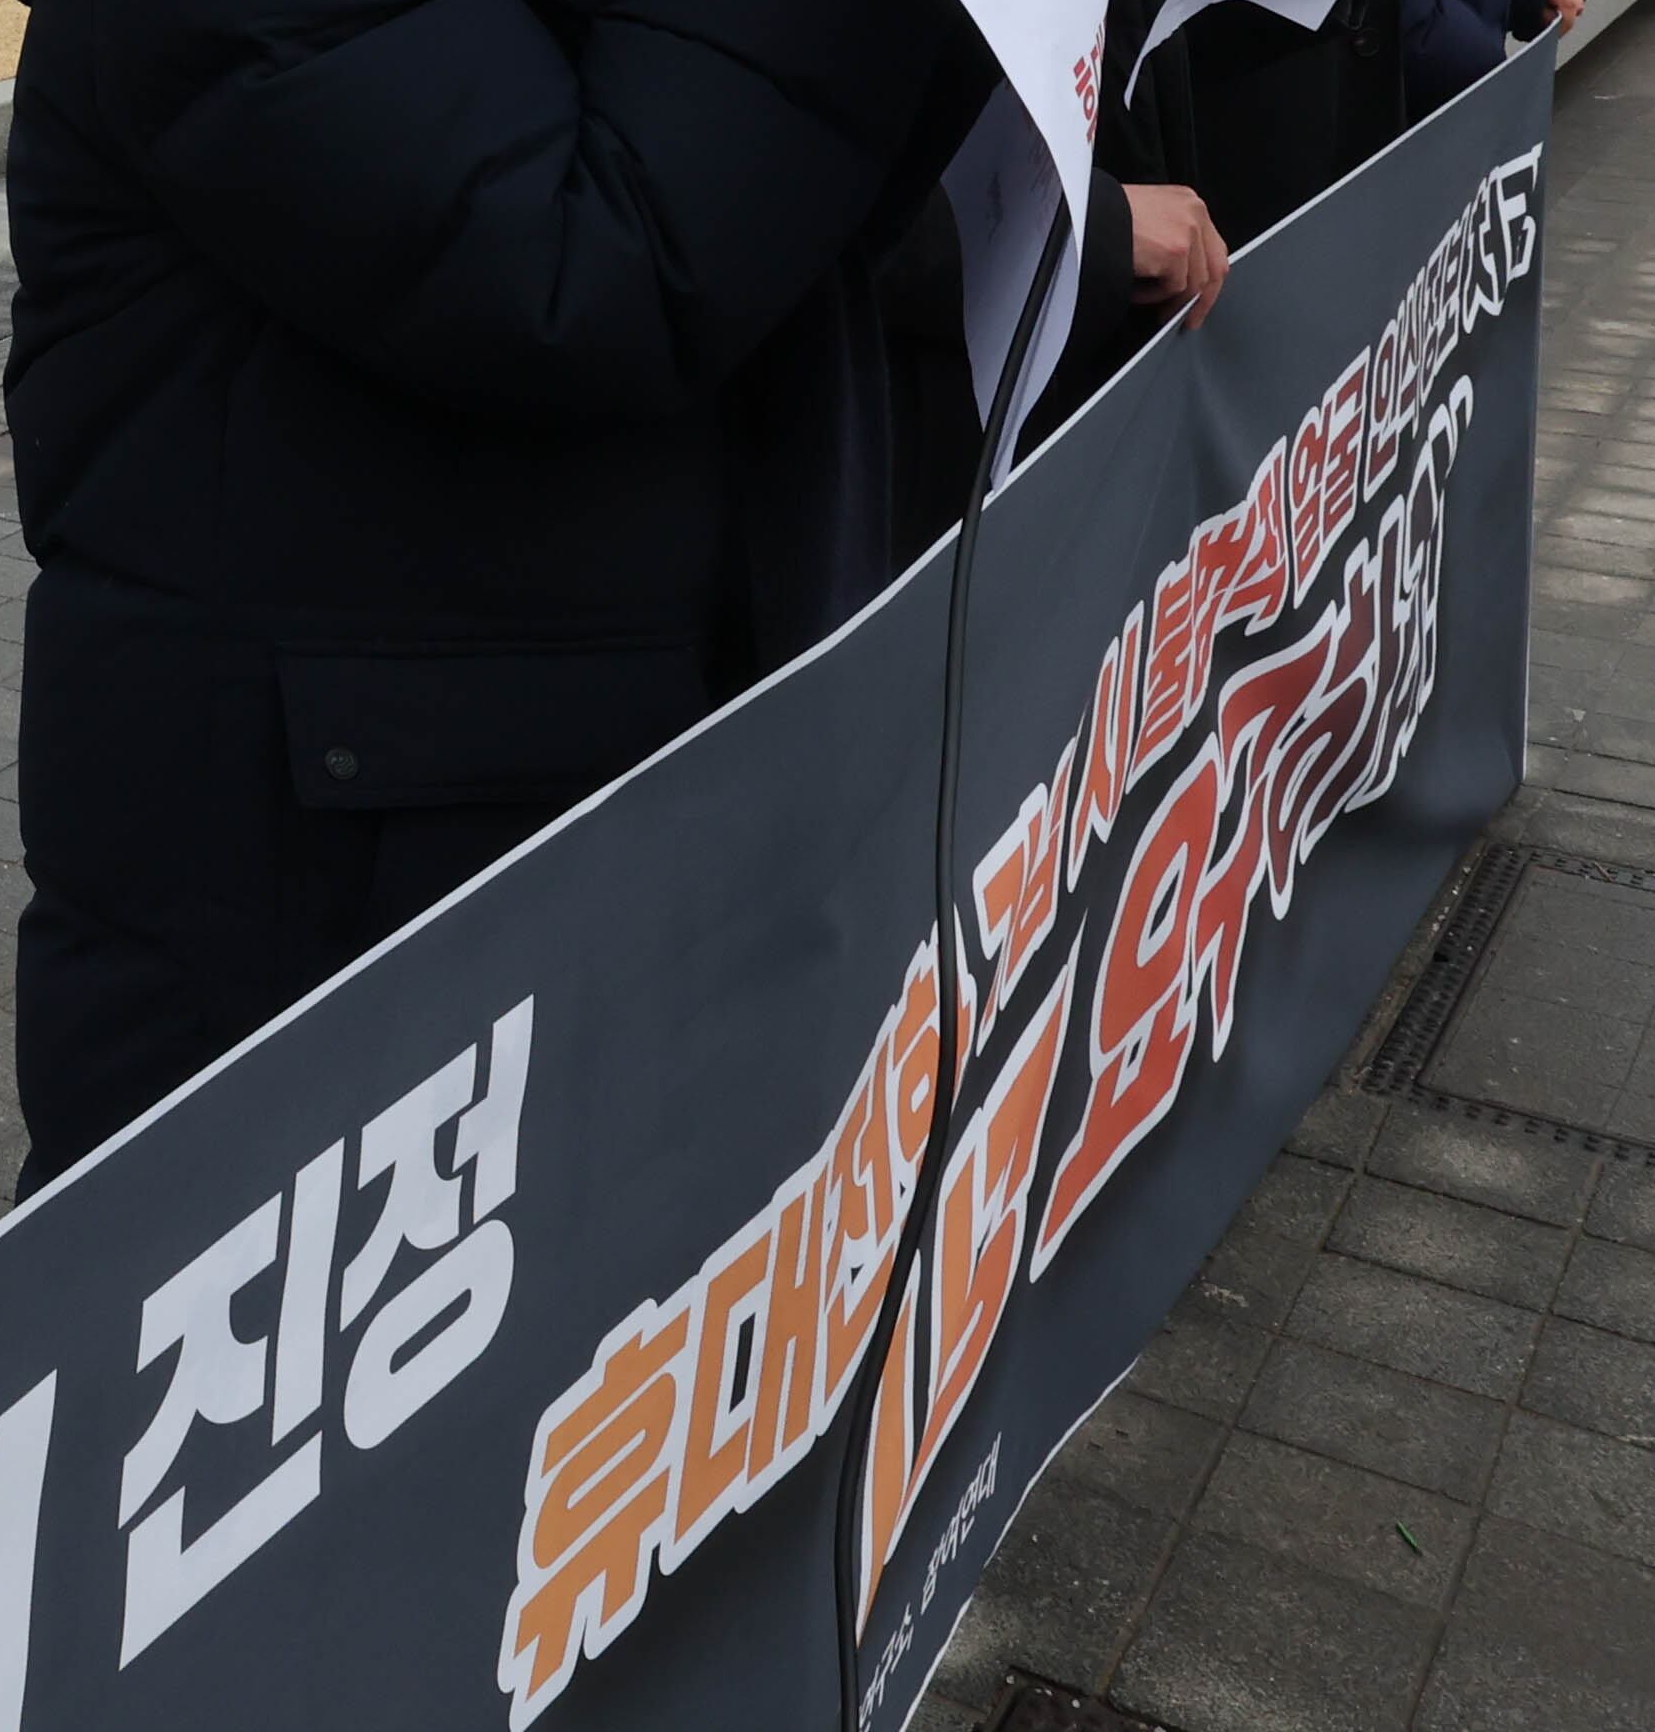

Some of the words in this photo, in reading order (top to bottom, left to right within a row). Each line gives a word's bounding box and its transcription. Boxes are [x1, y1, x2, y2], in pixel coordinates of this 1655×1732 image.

[119, 994, 534, 1671] 진정
[498, 908, 977, 1732] 휴대전화
[1289, 346, 1371, 609] 얼굴
